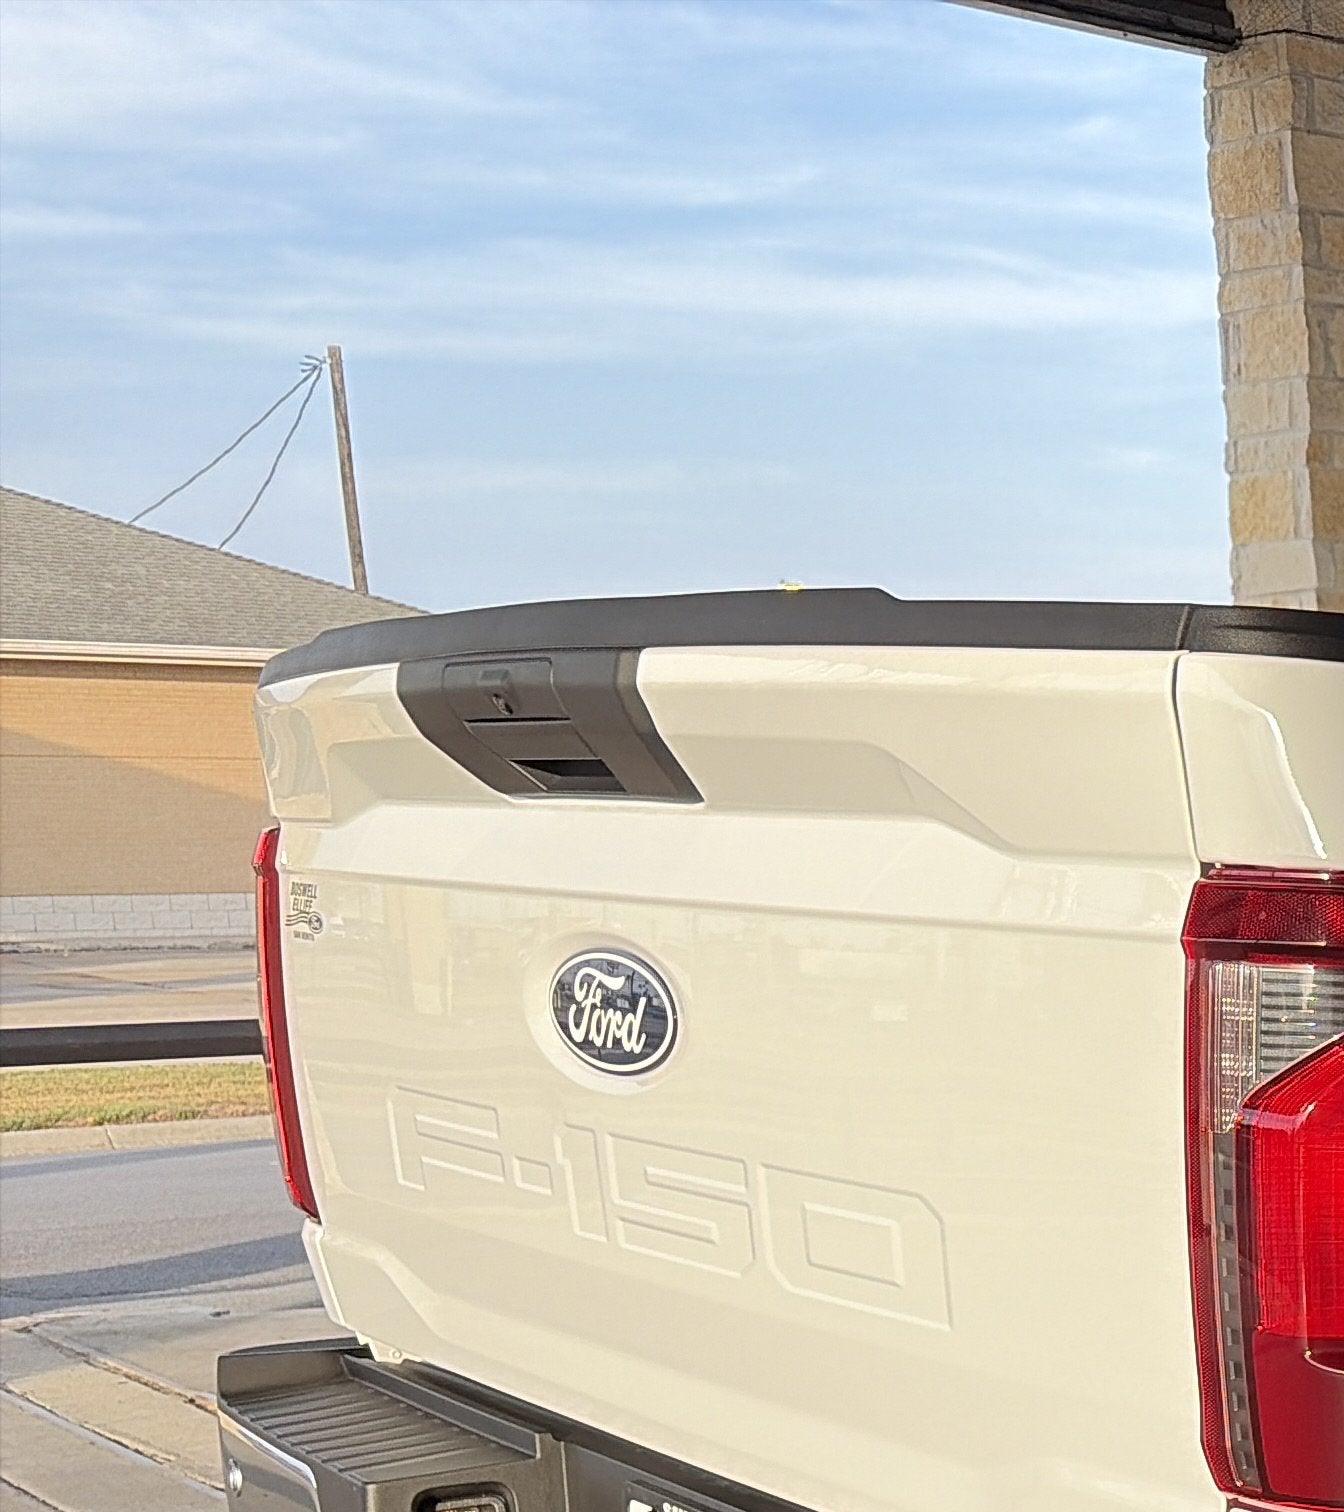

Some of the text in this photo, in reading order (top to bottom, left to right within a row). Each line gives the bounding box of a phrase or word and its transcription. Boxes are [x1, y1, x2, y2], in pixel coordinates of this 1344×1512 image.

[291, 881, 317, 898] BOSWELL
[567, 966, 648, 1055] Ford
[385, 1084, 954, 1332] F-150
